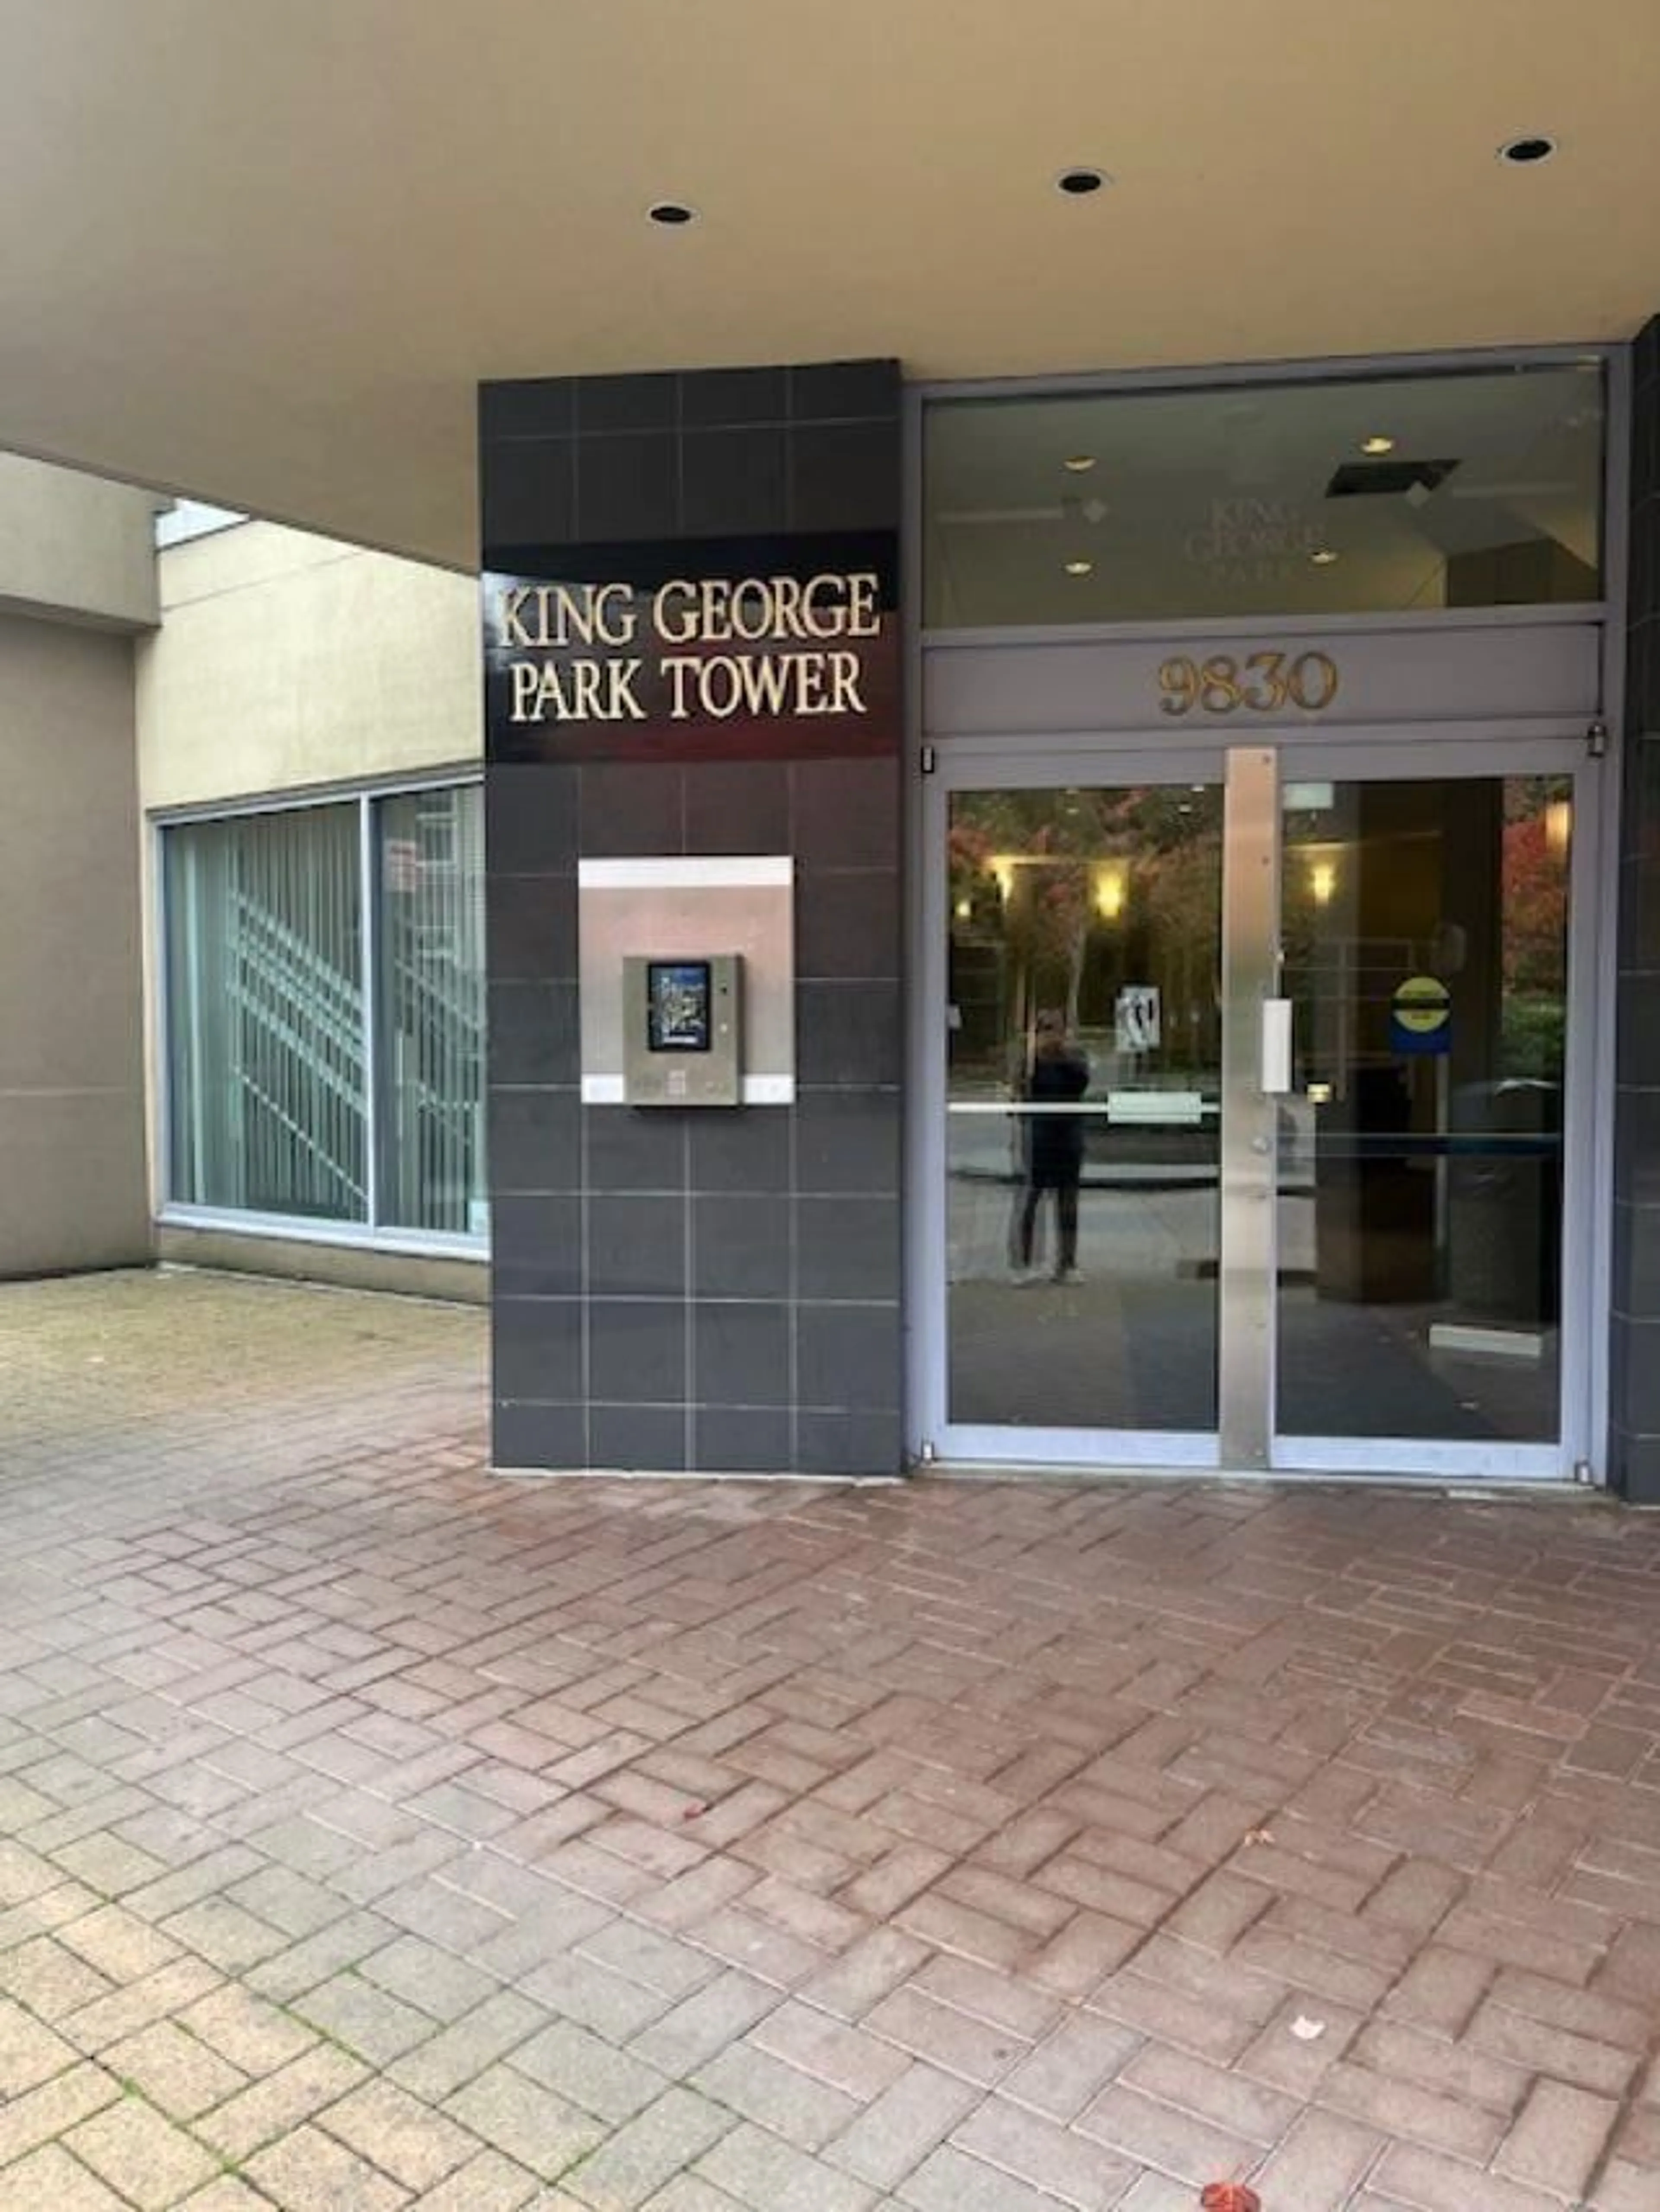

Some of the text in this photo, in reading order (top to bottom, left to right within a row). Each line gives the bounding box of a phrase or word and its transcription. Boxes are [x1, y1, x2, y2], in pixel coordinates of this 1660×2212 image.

[497, 573, 881, 648] KING GEORGE
[510, 650, 868, 722] PARK TOWER
[1159, 651, 1338, 717] 9830
